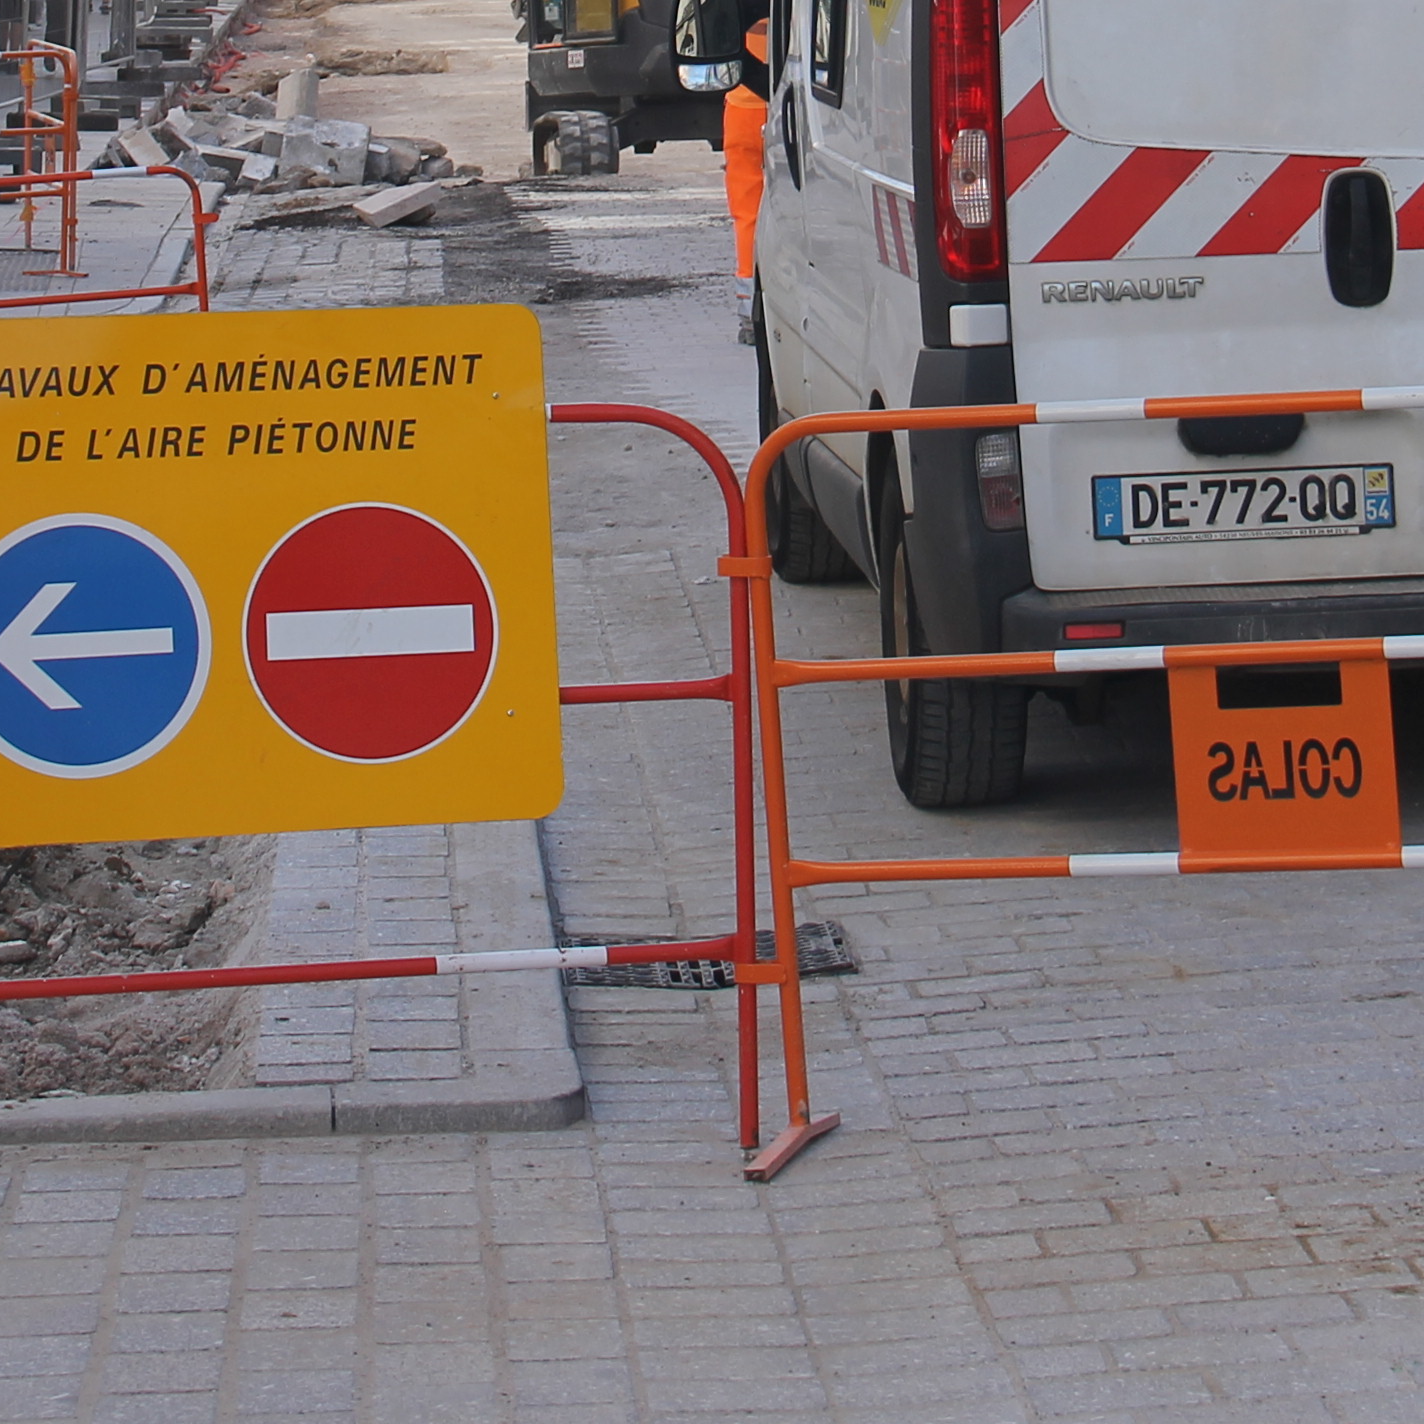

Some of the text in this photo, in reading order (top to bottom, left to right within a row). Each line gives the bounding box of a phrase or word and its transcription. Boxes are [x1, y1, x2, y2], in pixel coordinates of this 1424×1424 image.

[1041, 276, 1204, 304] RENAULT
[142, 353, 483, 396] D'AMÉNAGEMENT
[16, 417, 417, 463] DE L'AIRE PIÉTONNE
[1130, 472, 1358, 529] DE-772-QQ
[1365, 497, 1390, 520] 54
[1104, 514, 1114, 527] F
